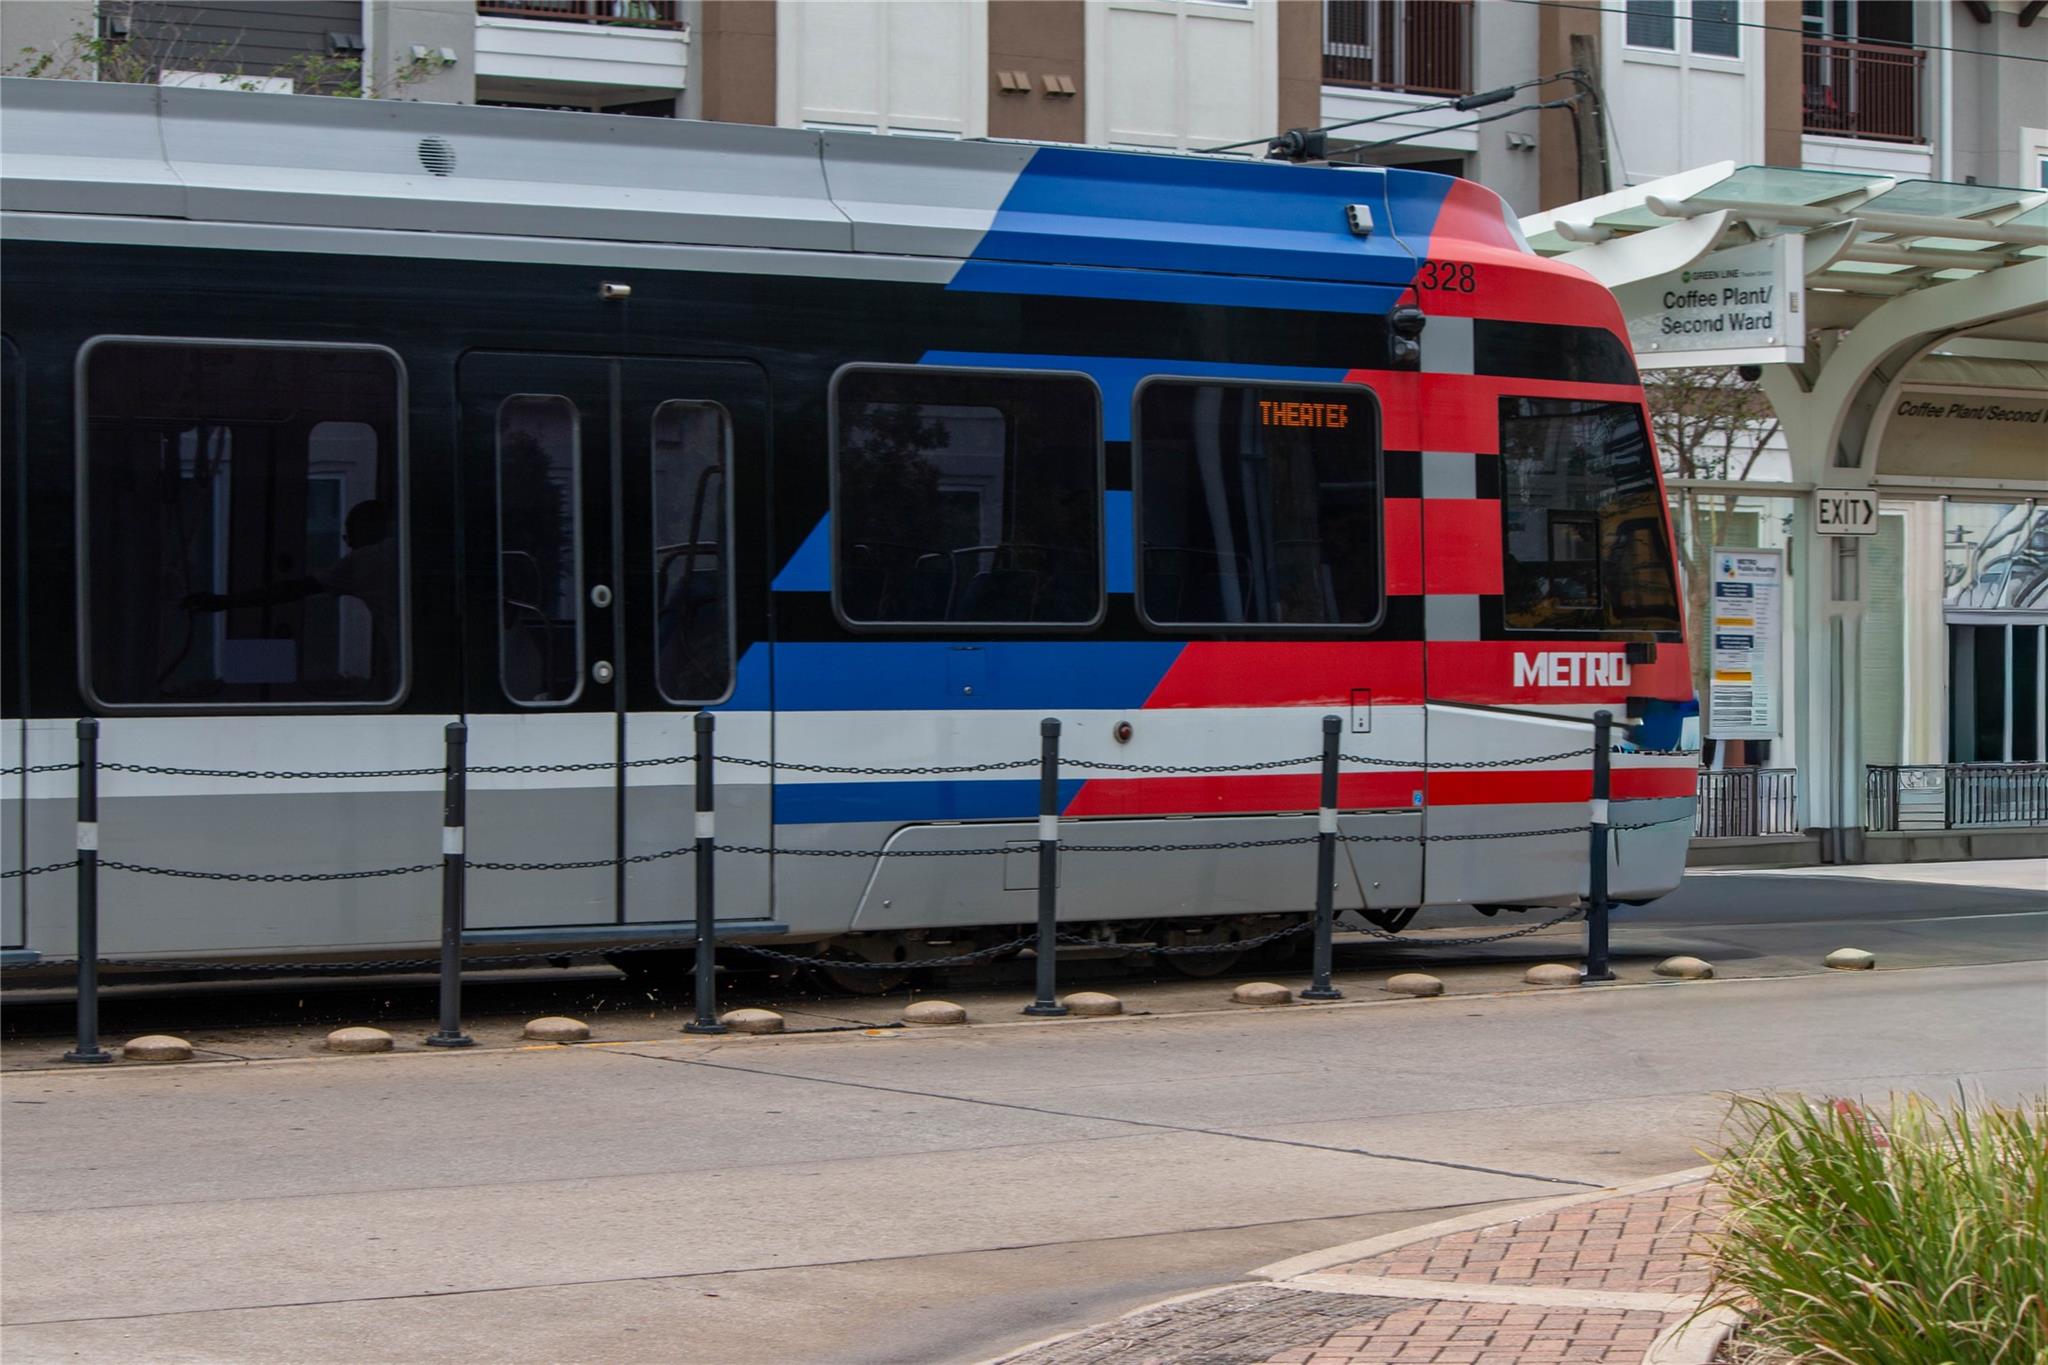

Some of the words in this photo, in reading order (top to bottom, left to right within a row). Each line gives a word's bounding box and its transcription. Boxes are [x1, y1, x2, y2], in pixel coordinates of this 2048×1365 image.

[1421, 261, 1476, 293] 328
[1692, 271, 1719, 280] GREEN
[1721, 269, 1739, 279] LINE
[1663, 290, 1718, 309] Coffee
[1723, 285, 1773, 306] Plant/
[1661, 314, 1724, 334] Second
[1728, 311, 1772, 331] Ward
[1898, 401, 1945, 418] Coffee
[1820, 499, 1860, 524] EXIT
[1512, 651, 1631, 687] METRO
